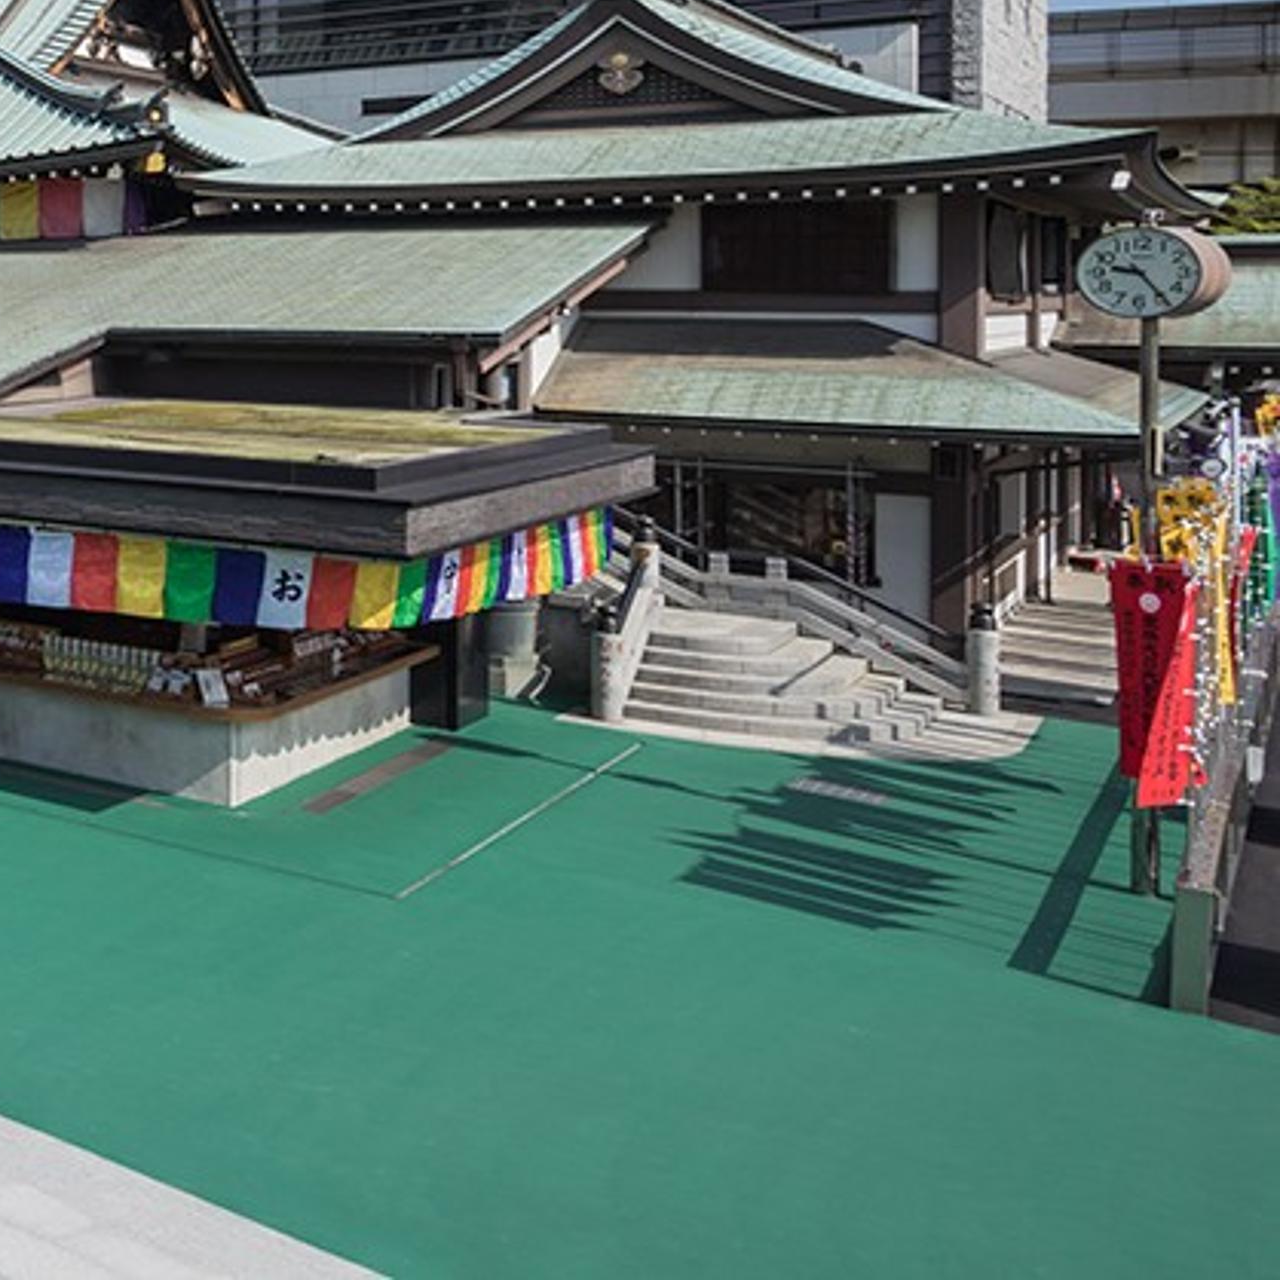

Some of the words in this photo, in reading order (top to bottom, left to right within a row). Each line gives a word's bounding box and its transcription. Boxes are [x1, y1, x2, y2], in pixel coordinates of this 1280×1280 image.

[1133, 235, 1152, 252] 12
[1094, 251, 1115, 264] 10
[1092, 267, 1106, 279] 9
[1099, 280, 1112, 293] 8
[1114, 291, 1127, 304] 7
[1133, 295, 1146, 310] 6
